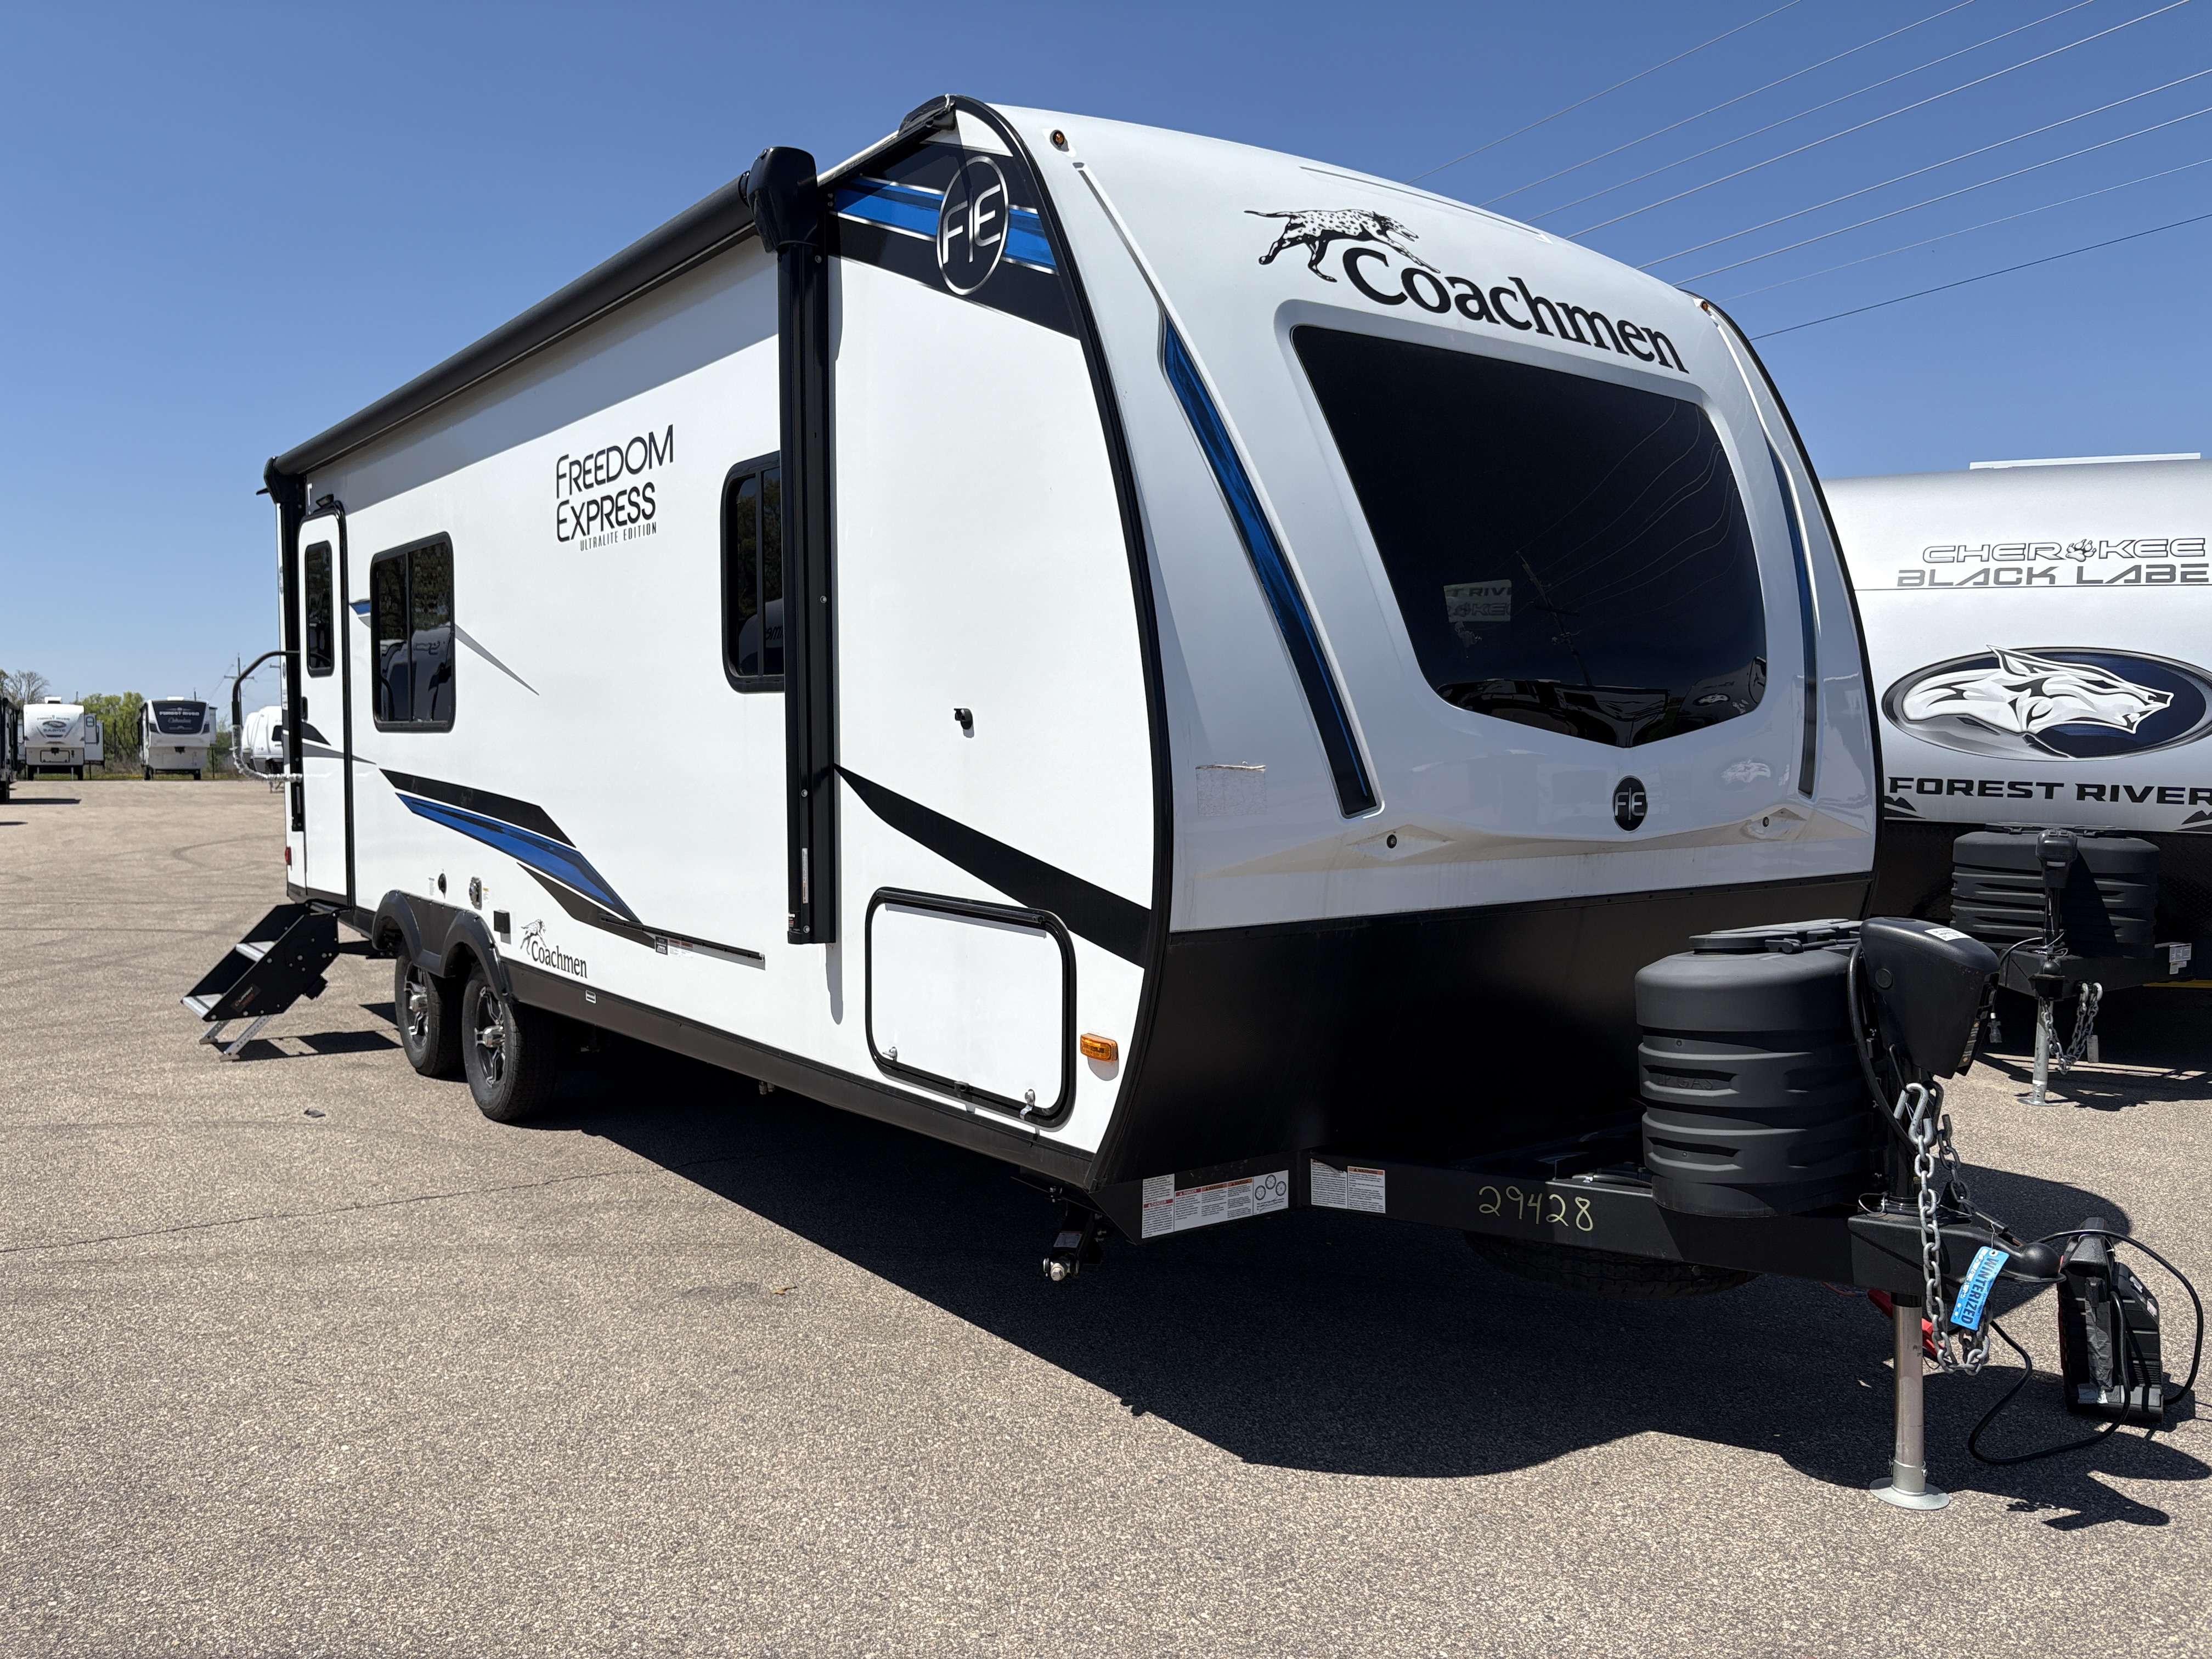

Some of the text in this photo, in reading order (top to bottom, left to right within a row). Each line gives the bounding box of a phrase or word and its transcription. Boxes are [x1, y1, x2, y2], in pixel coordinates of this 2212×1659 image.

[1342, 247, 1690, 374] Coachmen
[556, 424, 673, 499] FREEDOM
[557, 482, 656, 543] EXPRESS
[580, 521, 657, 551] ULTRALITE EDITION
[1897, 566, 2059, 587] BLACK
[1888, 777, 2212, 806] FOREST RIVER
[531, 940, 588, 979] Coachmen
[1677, 1076, 1713, 1090] GAS
[1479, 1186, 1593, 1231] 29428
[1961, 1257, 1999, 1324] WINTERIZED
